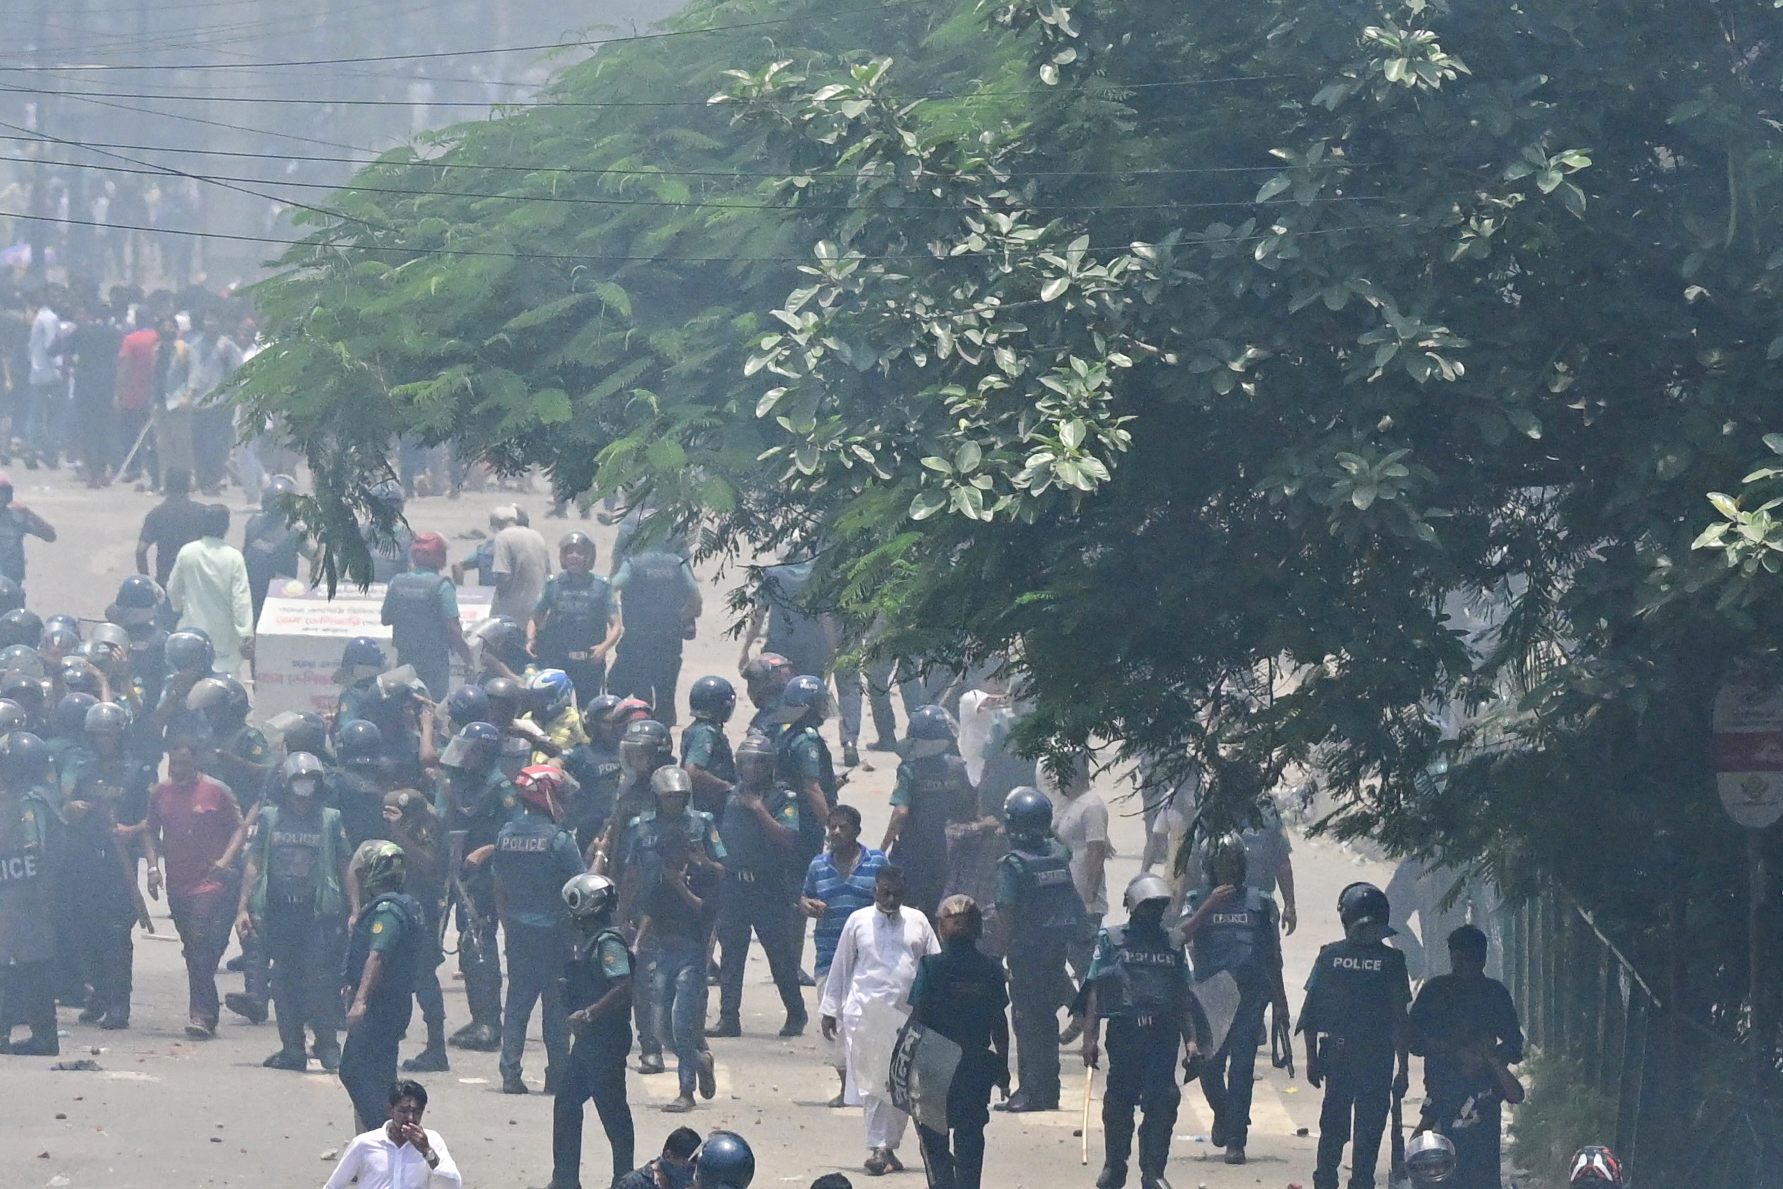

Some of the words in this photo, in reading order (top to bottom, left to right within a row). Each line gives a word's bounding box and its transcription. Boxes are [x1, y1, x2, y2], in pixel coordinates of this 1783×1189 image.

[502, 837, 546, 852] POLICE
[1124, 951, 1175, 966] POLICE
[1333, 957, 1381, 971] POLICE
